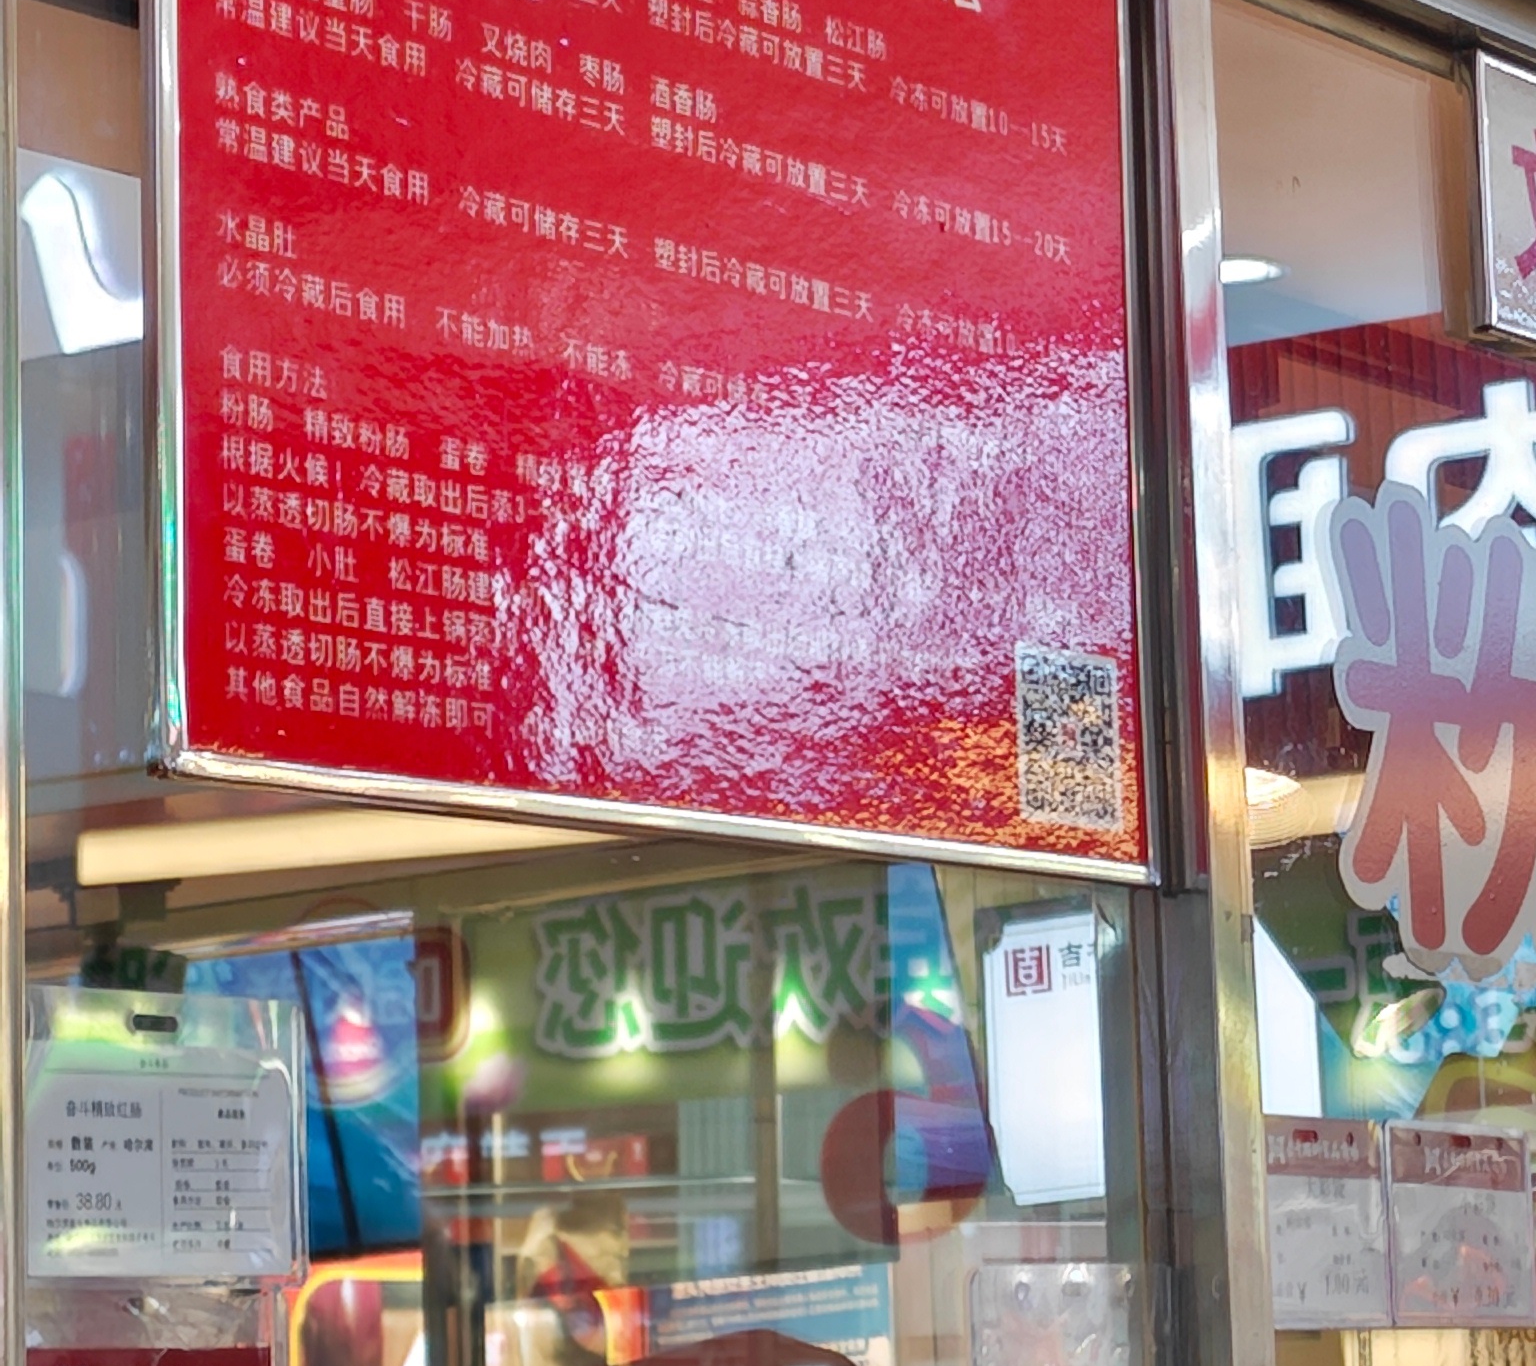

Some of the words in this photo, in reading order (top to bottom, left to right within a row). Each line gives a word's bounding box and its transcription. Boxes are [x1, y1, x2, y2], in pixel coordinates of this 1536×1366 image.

[404, 0, 452, 43] 干肠
[479, 20, 553, 75] 叉烧肉
[579, 51, 625, 96] 枣肠
[650, 74, 717, 125] 酒香肠
[825, 14, 888, 62] 松江肠
[214, 70, 349, 143] 熟食类产品
[455, 56, 625, 137] 冷藏可储存三天
[650, 115, 870, 208] 塑封后冷藏可放置三天
[215, 118, 430, 207] 常温建议当天食用
[458, 184, 629, 260] 冷藏可储存三天
[653, 236, 874, 324] 塑封后冷藏可放置三天
[218, 208, 297, 259] 水晶肚
[218, 254, 406, 330] 必须冷藏后食用
[436, 305, 535, 356] 不能加热
[563, 333, 633, 382] 不能冻
[220, 343, 328, 400] 食用方法
[220, 388, 274, 433] 粉肠
[304, 407, 410, 461] 精致粉肠
[440, 436, 490, 477] 蛋卷
[220, 435, 329, 489] 根据火候
[221, 482, 490, 563] 以蒸透切肠不爆为标准
[223, 526, 275, 569] 蛋卷
[308, 543, 358, 584] 小肚
[225, 621, 493, 691] 以蒸透切肠不爆为标准
[226, 666, 494, 738] 其他食品自然解冻即可
[1058, 941, 1096, 968] 吉
[69, 1157, 96, 1175] 500g
